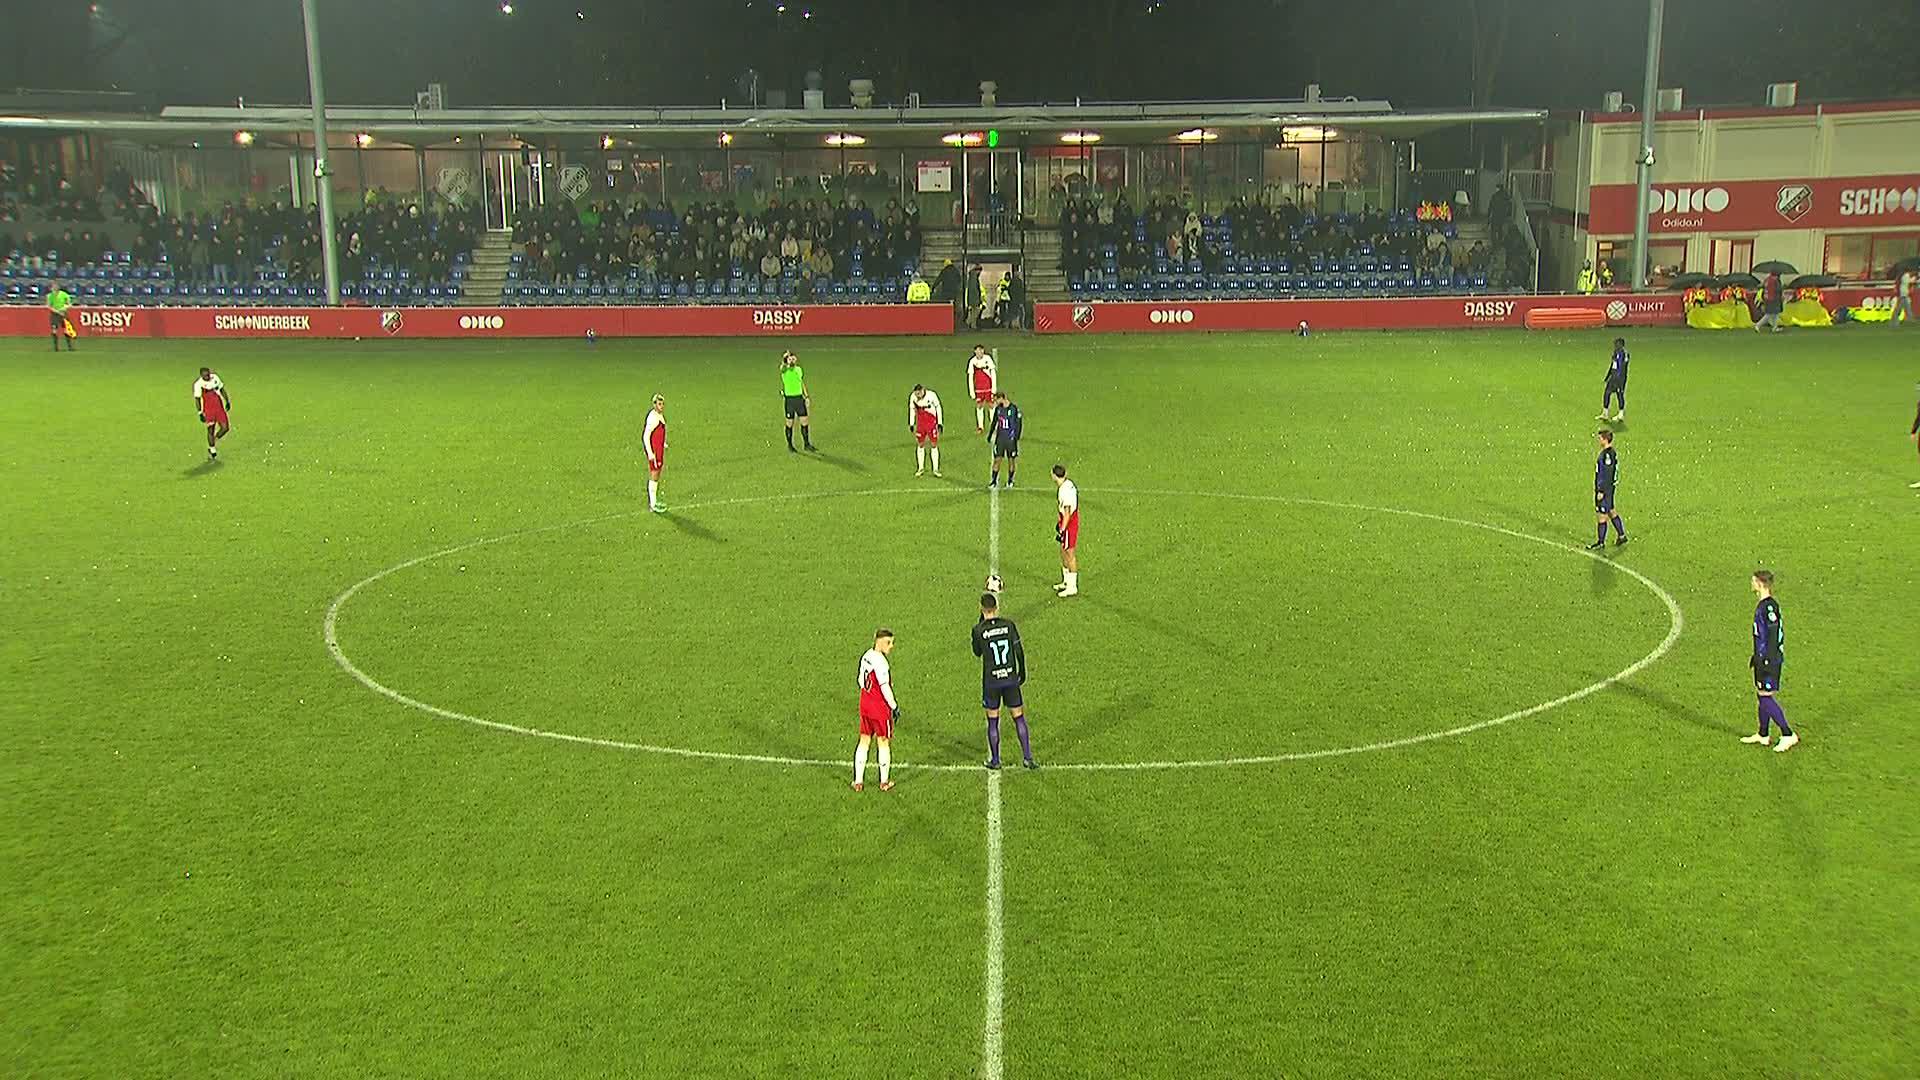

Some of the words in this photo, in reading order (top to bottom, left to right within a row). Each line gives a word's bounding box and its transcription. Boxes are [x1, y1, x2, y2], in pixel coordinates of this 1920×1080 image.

[1839, 186, 1920, 216] SCHOO
[1464, 300, 1515, 316] DASSY
[1628, 301, 1665, 311] LINKIT
[80, 311, 133, 327] DASSY
[214, 314, 310, 330] SCHOONDERBEEK
[753, 310, 803, 325] DASSY
[989, 639, 1010, 666] 17
